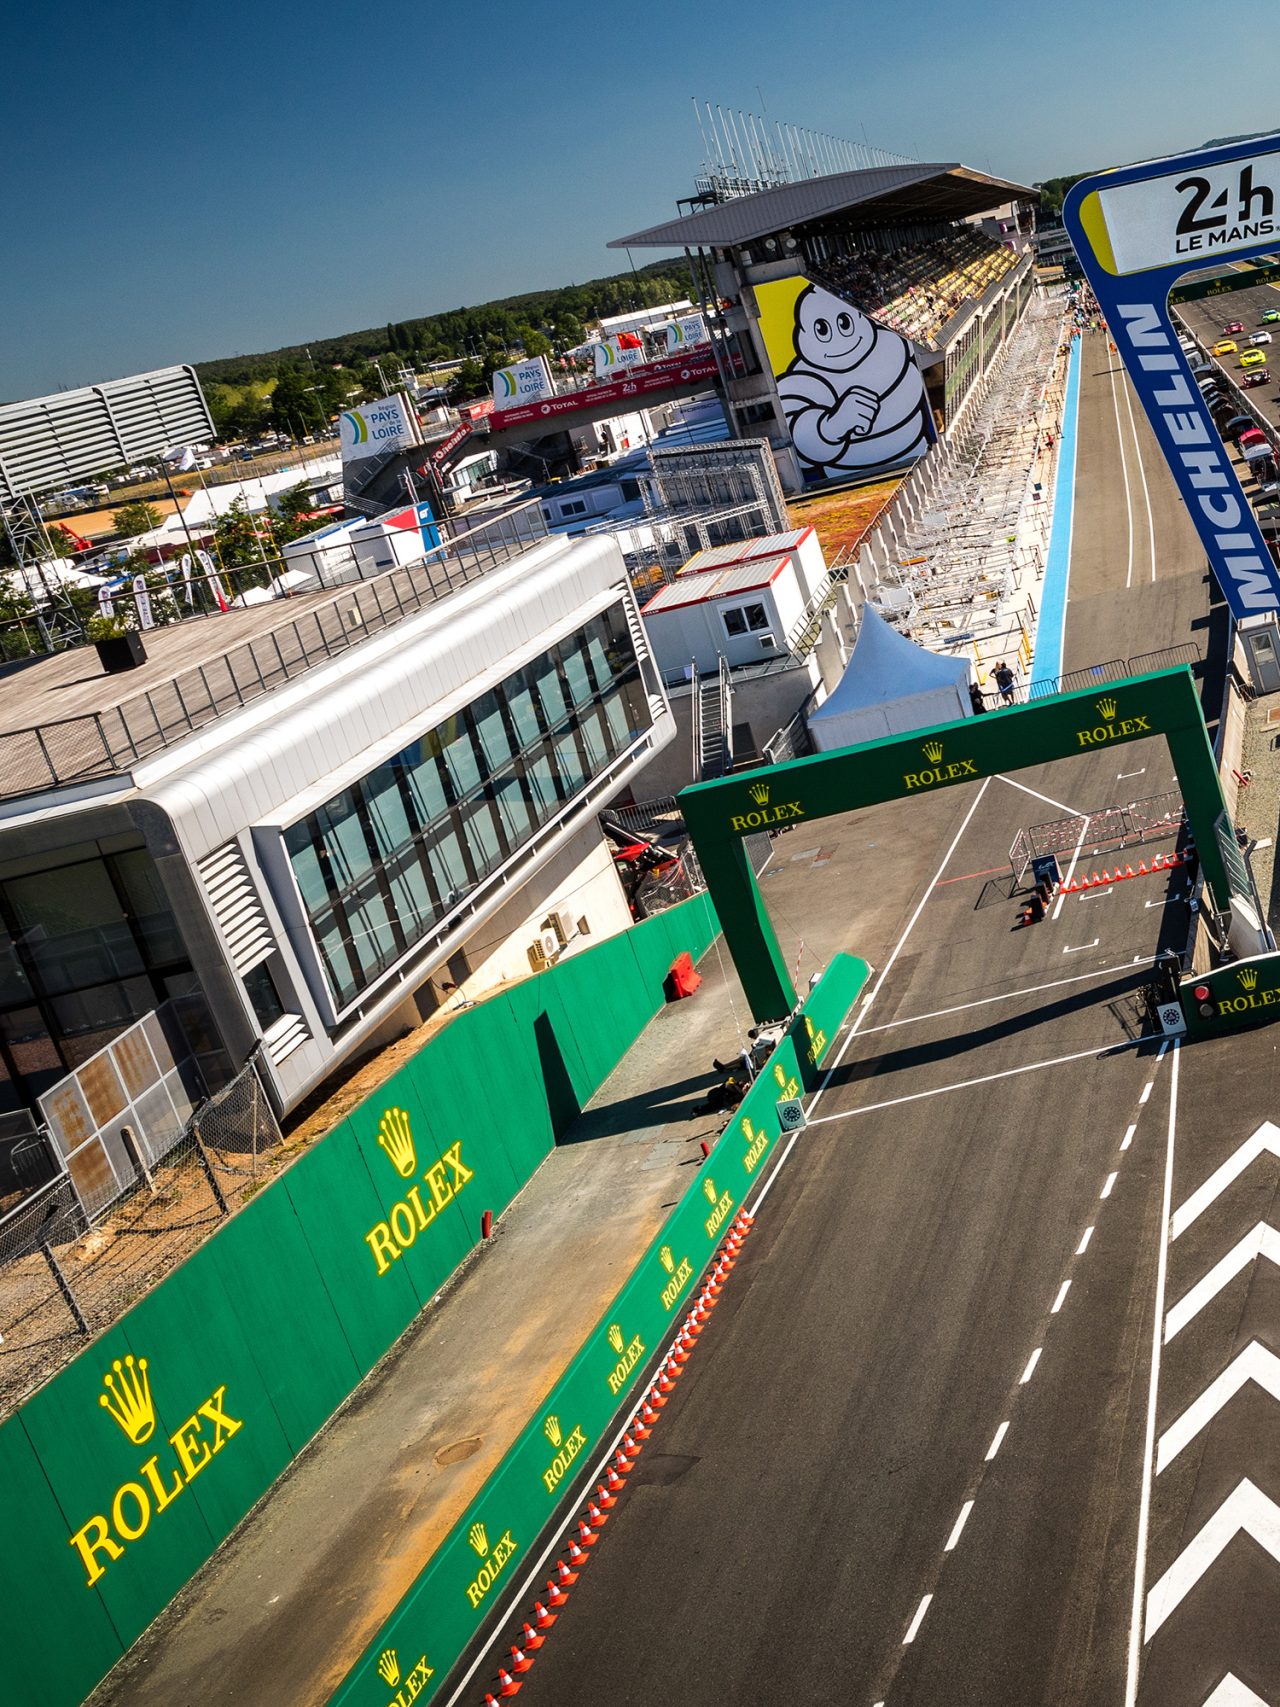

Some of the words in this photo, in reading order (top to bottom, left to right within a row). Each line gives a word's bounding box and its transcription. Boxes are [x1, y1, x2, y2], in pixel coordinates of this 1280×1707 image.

[1175, 164, 1274, 236] 24h
[1176, 235, 1203, 254] LE
[1208, 219, 1275, 247] MANS
[519, 369, 542, 381] PAYS
[616, 352, 639, 364] LOIRE
[690, 366, 718, 376] TOTAL
[519, 381, 546, 394] LOIRE
[371, 410, 399, 424] PAYS
[550, 400, 579, 411] TOTAL
[372, 425, 404, 440] LOIRE
[1116, 303, 1280, 609] MICHELIN
[1076, 715, 1151, 746] ROLEX
[904, 759, 978, 789] ROLEX
[730, 801, 805, 832] ROLEX
[743, 1131, 769, 1173] ROLEX
[364, 1140, 475, 1277] ROLEX
[705, 1191, 734, 1238] ROLEX
[661, 1258, 693, 1311] ROLEX
[608, 1335, 645, 1395] ROLEX
[543, 1425, 587, 1494] ROLEX
[69, 1384, 244, 1588] ROLEX
[467, 1531, 518, 1609] ROLEX
